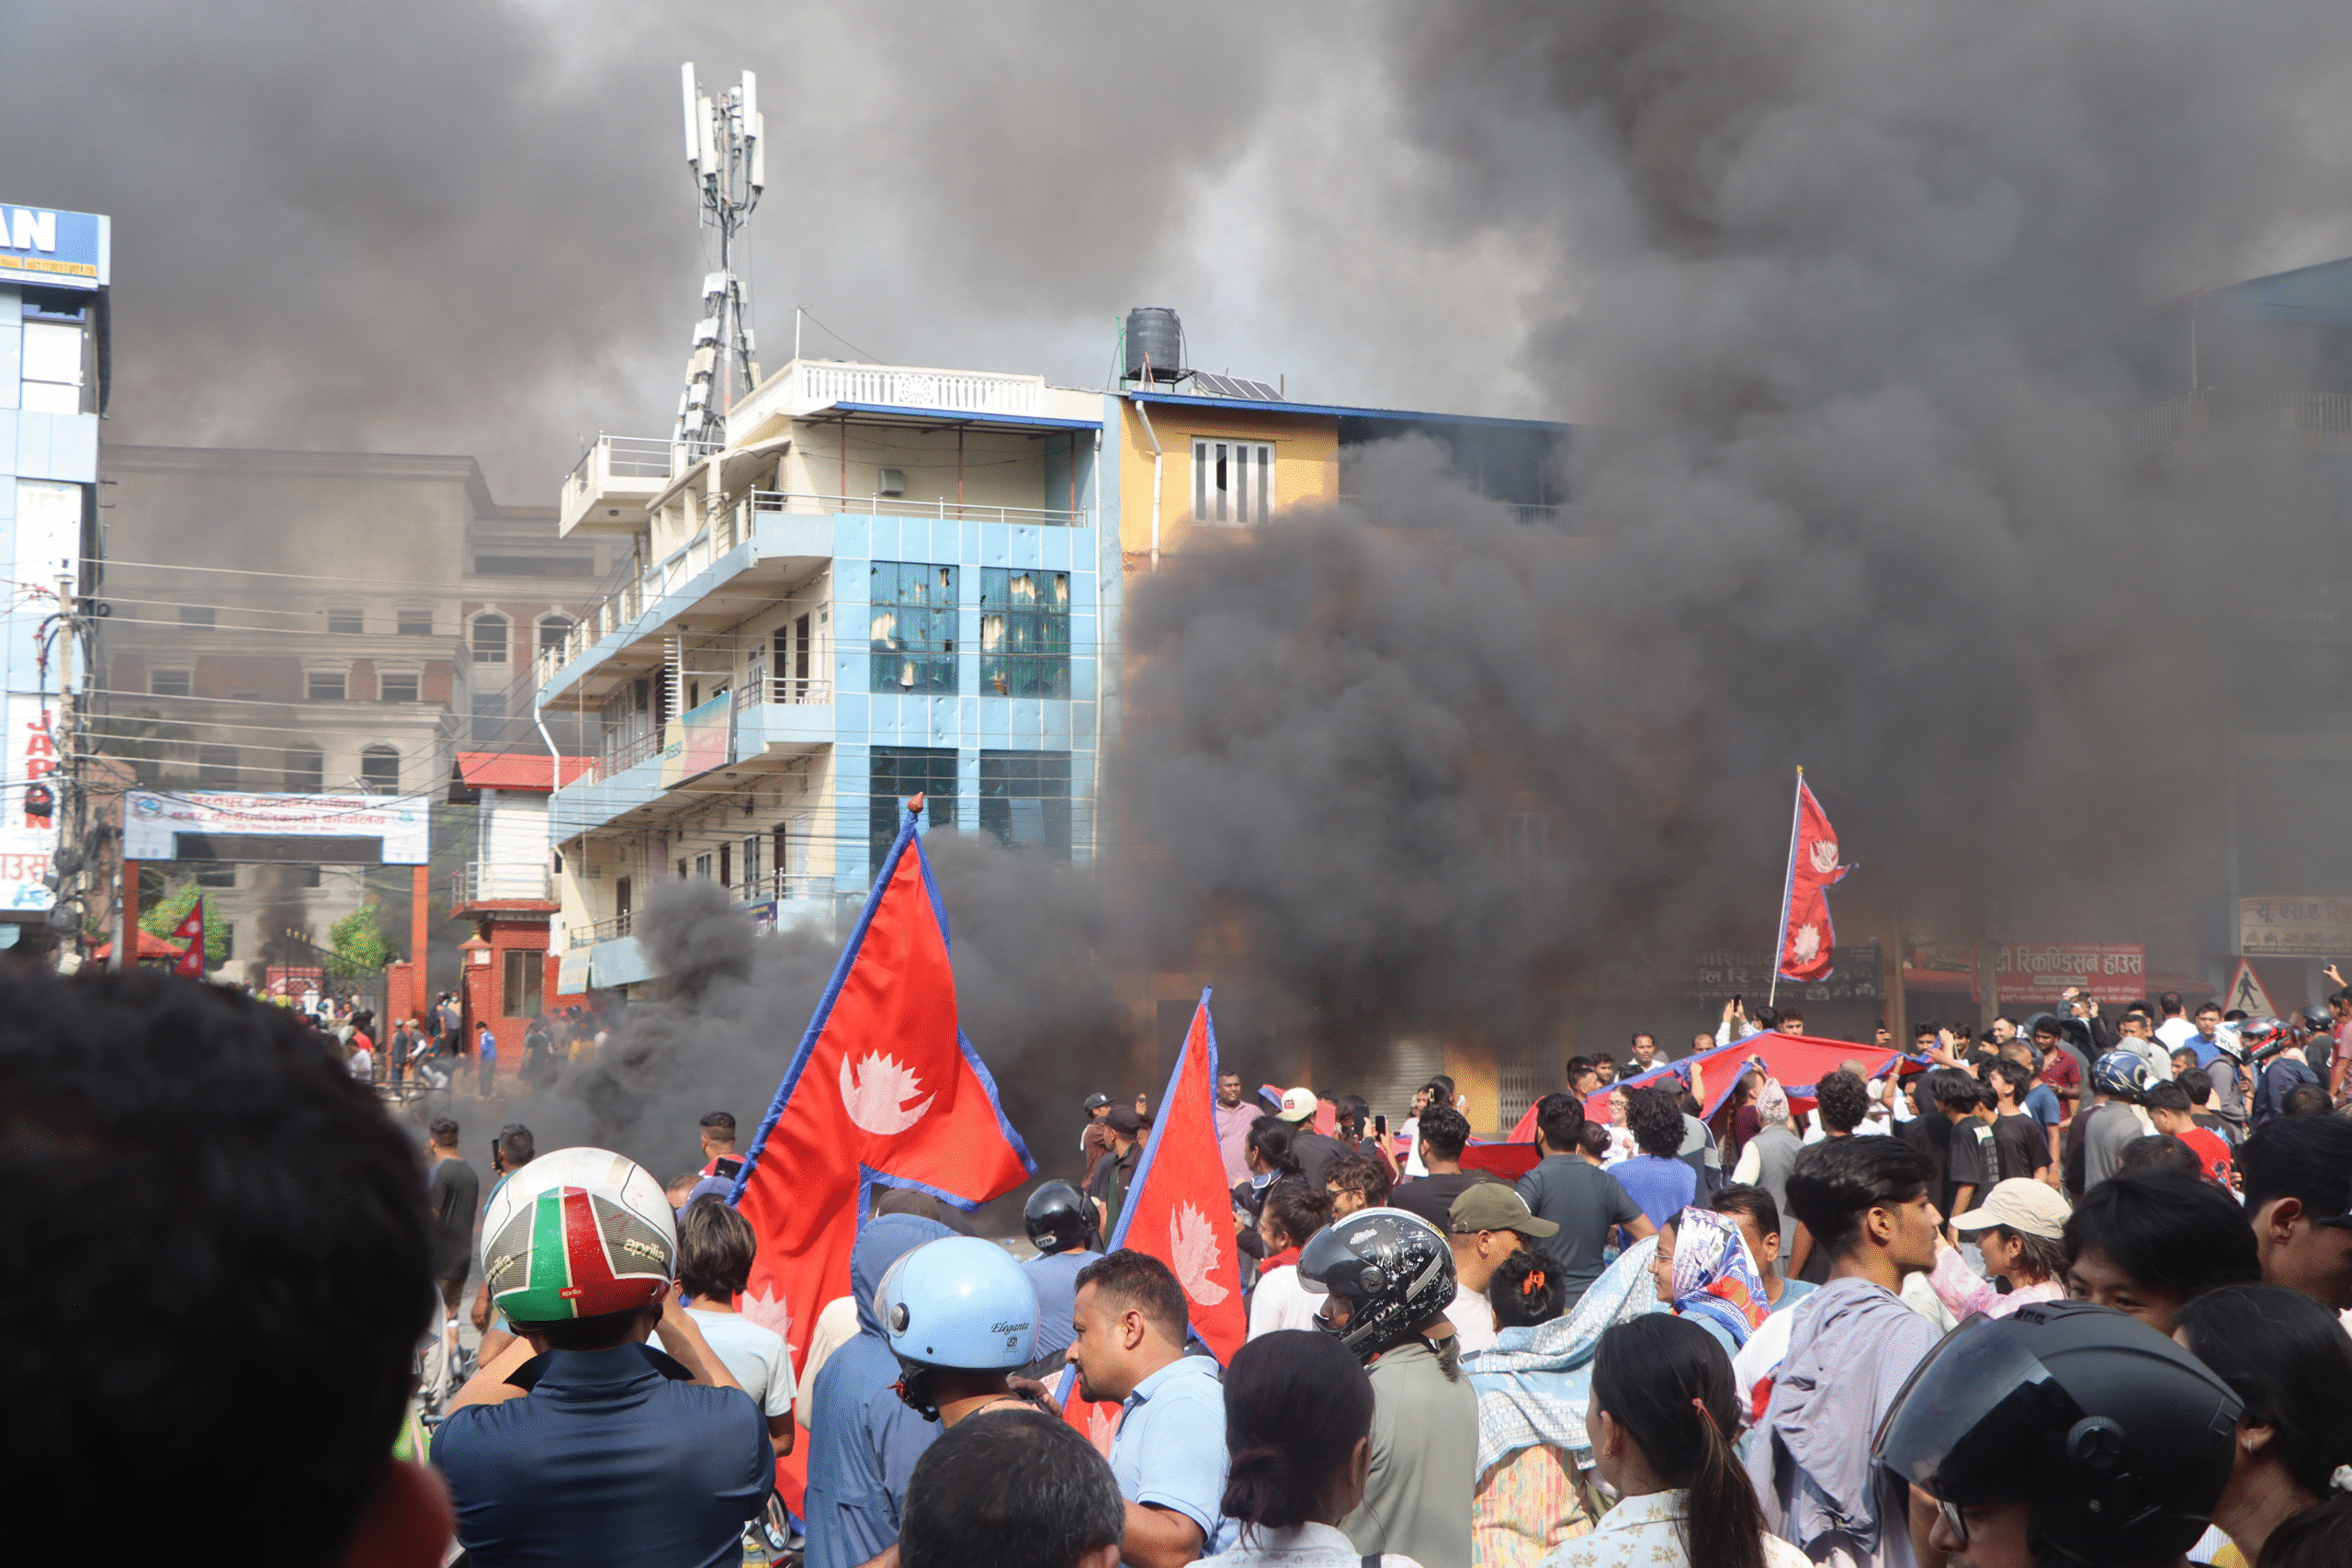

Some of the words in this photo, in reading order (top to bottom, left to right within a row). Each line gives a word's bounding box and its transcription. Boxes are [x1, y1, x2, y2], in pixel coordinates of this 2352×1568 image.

[0, 207, 56, 252] N
[2103, 953, 2143, 976] हाउस
[624, 1238, 665, 1262] aprilia
[561, 1289, 582, 1297] aprilia
[991, 1321, 1029, 1336] Elegante
